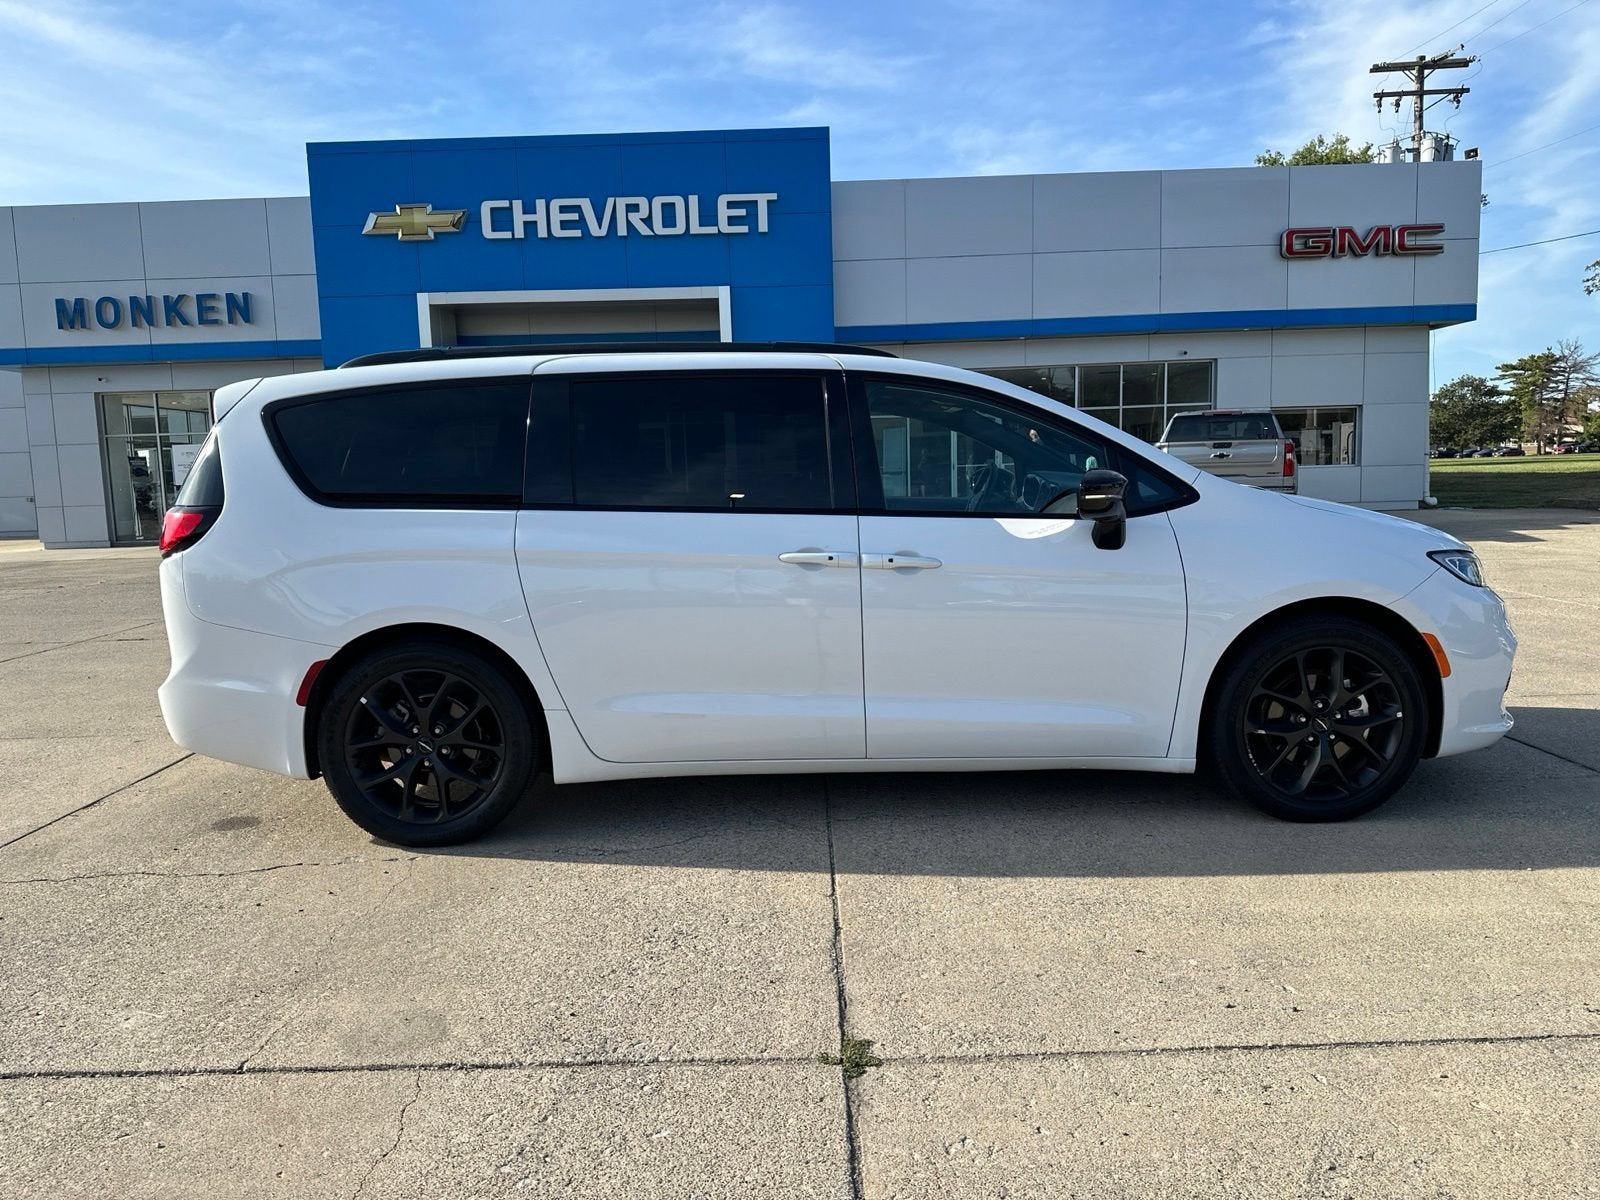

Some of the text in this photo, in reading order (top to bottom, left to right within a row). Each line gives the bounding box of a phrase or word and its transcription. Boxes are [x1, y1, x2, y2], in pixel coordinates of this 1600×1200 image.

[480, 193, 778, 239] CHEVROLET
[1281, 223, 1446, 259] GMC
[55, 292, 253, 331] MONKEN
